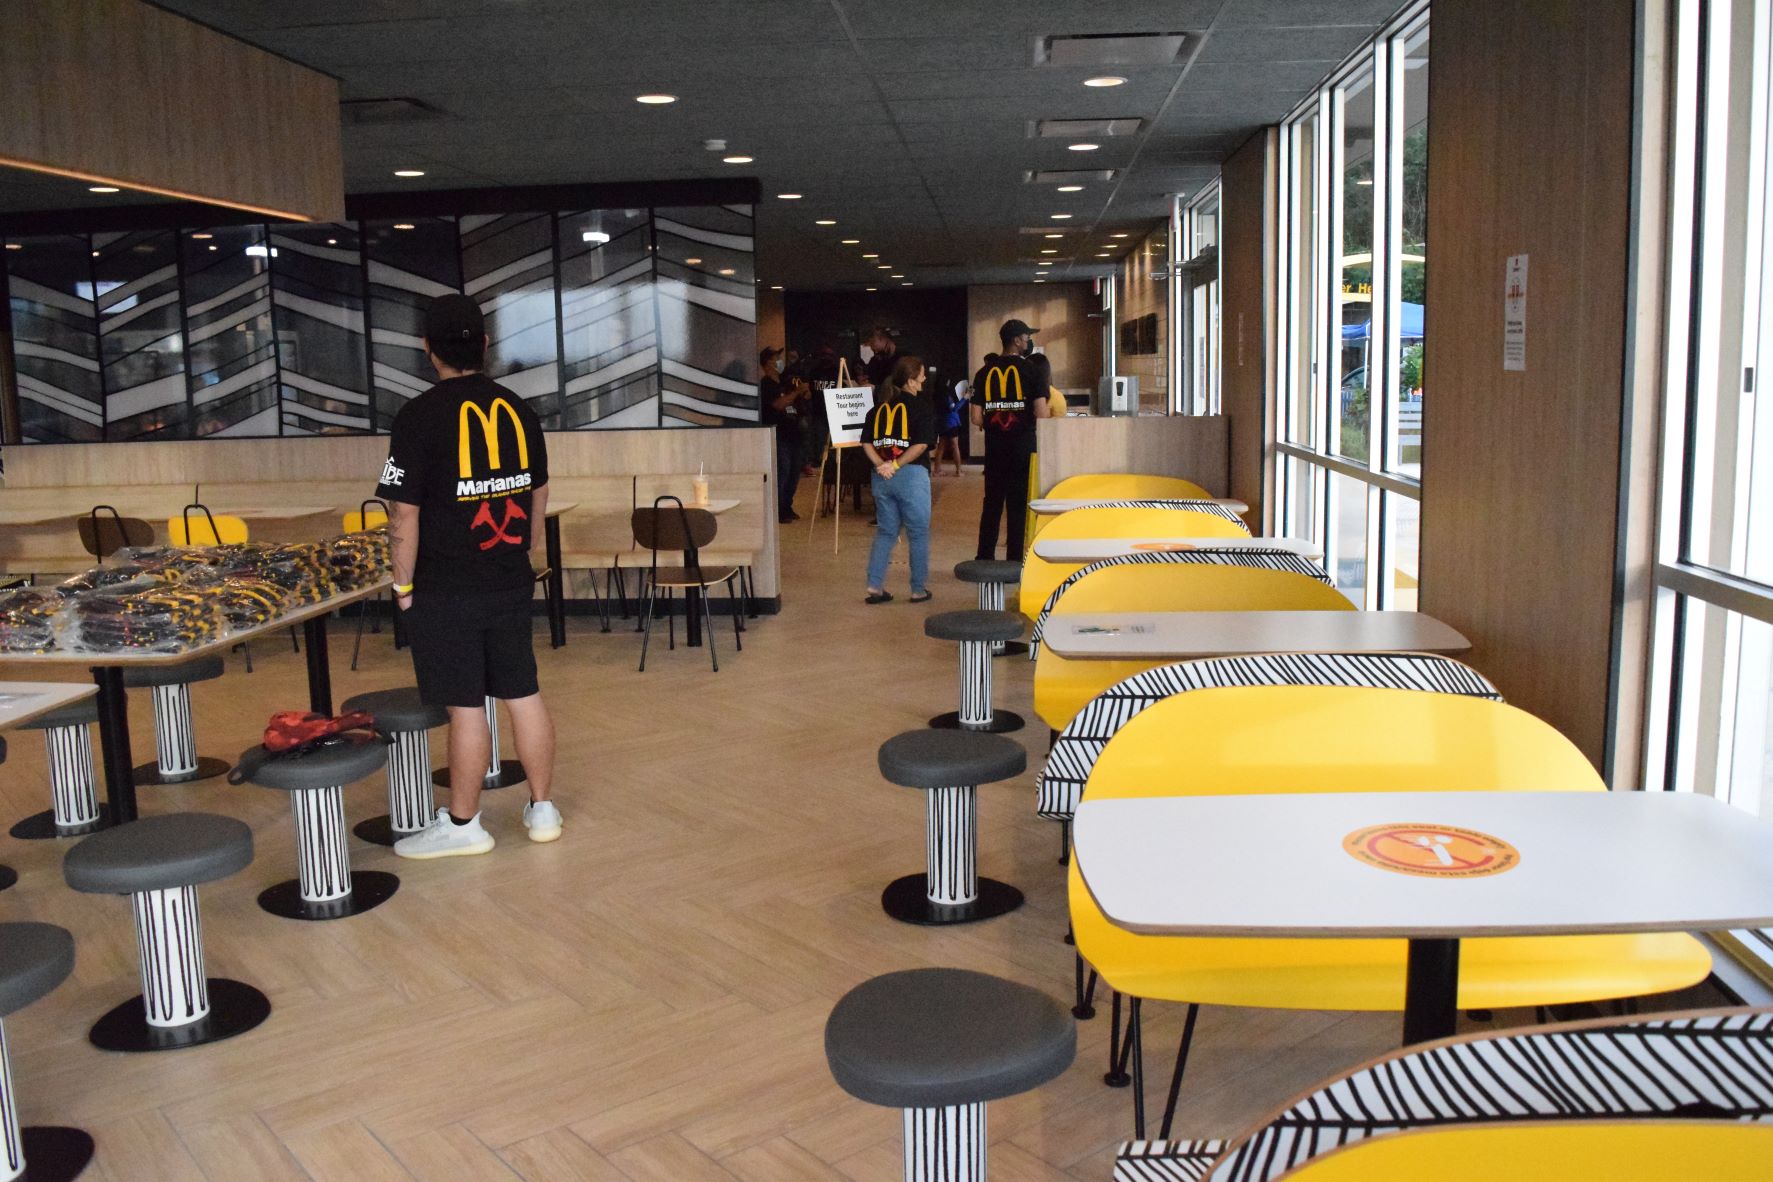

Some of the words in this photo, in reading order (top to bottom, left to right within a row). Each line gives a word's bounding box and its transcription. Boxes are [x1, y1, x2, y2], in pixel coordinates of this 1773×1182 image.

[835, 392, 864, 400] Restaurant
[848, 401, 866, 410] begins
[986, 401, 1024, 409] Marianas
[873, 438, 910, 448] Marianas
[456, 472, 532, 496] Marianas
